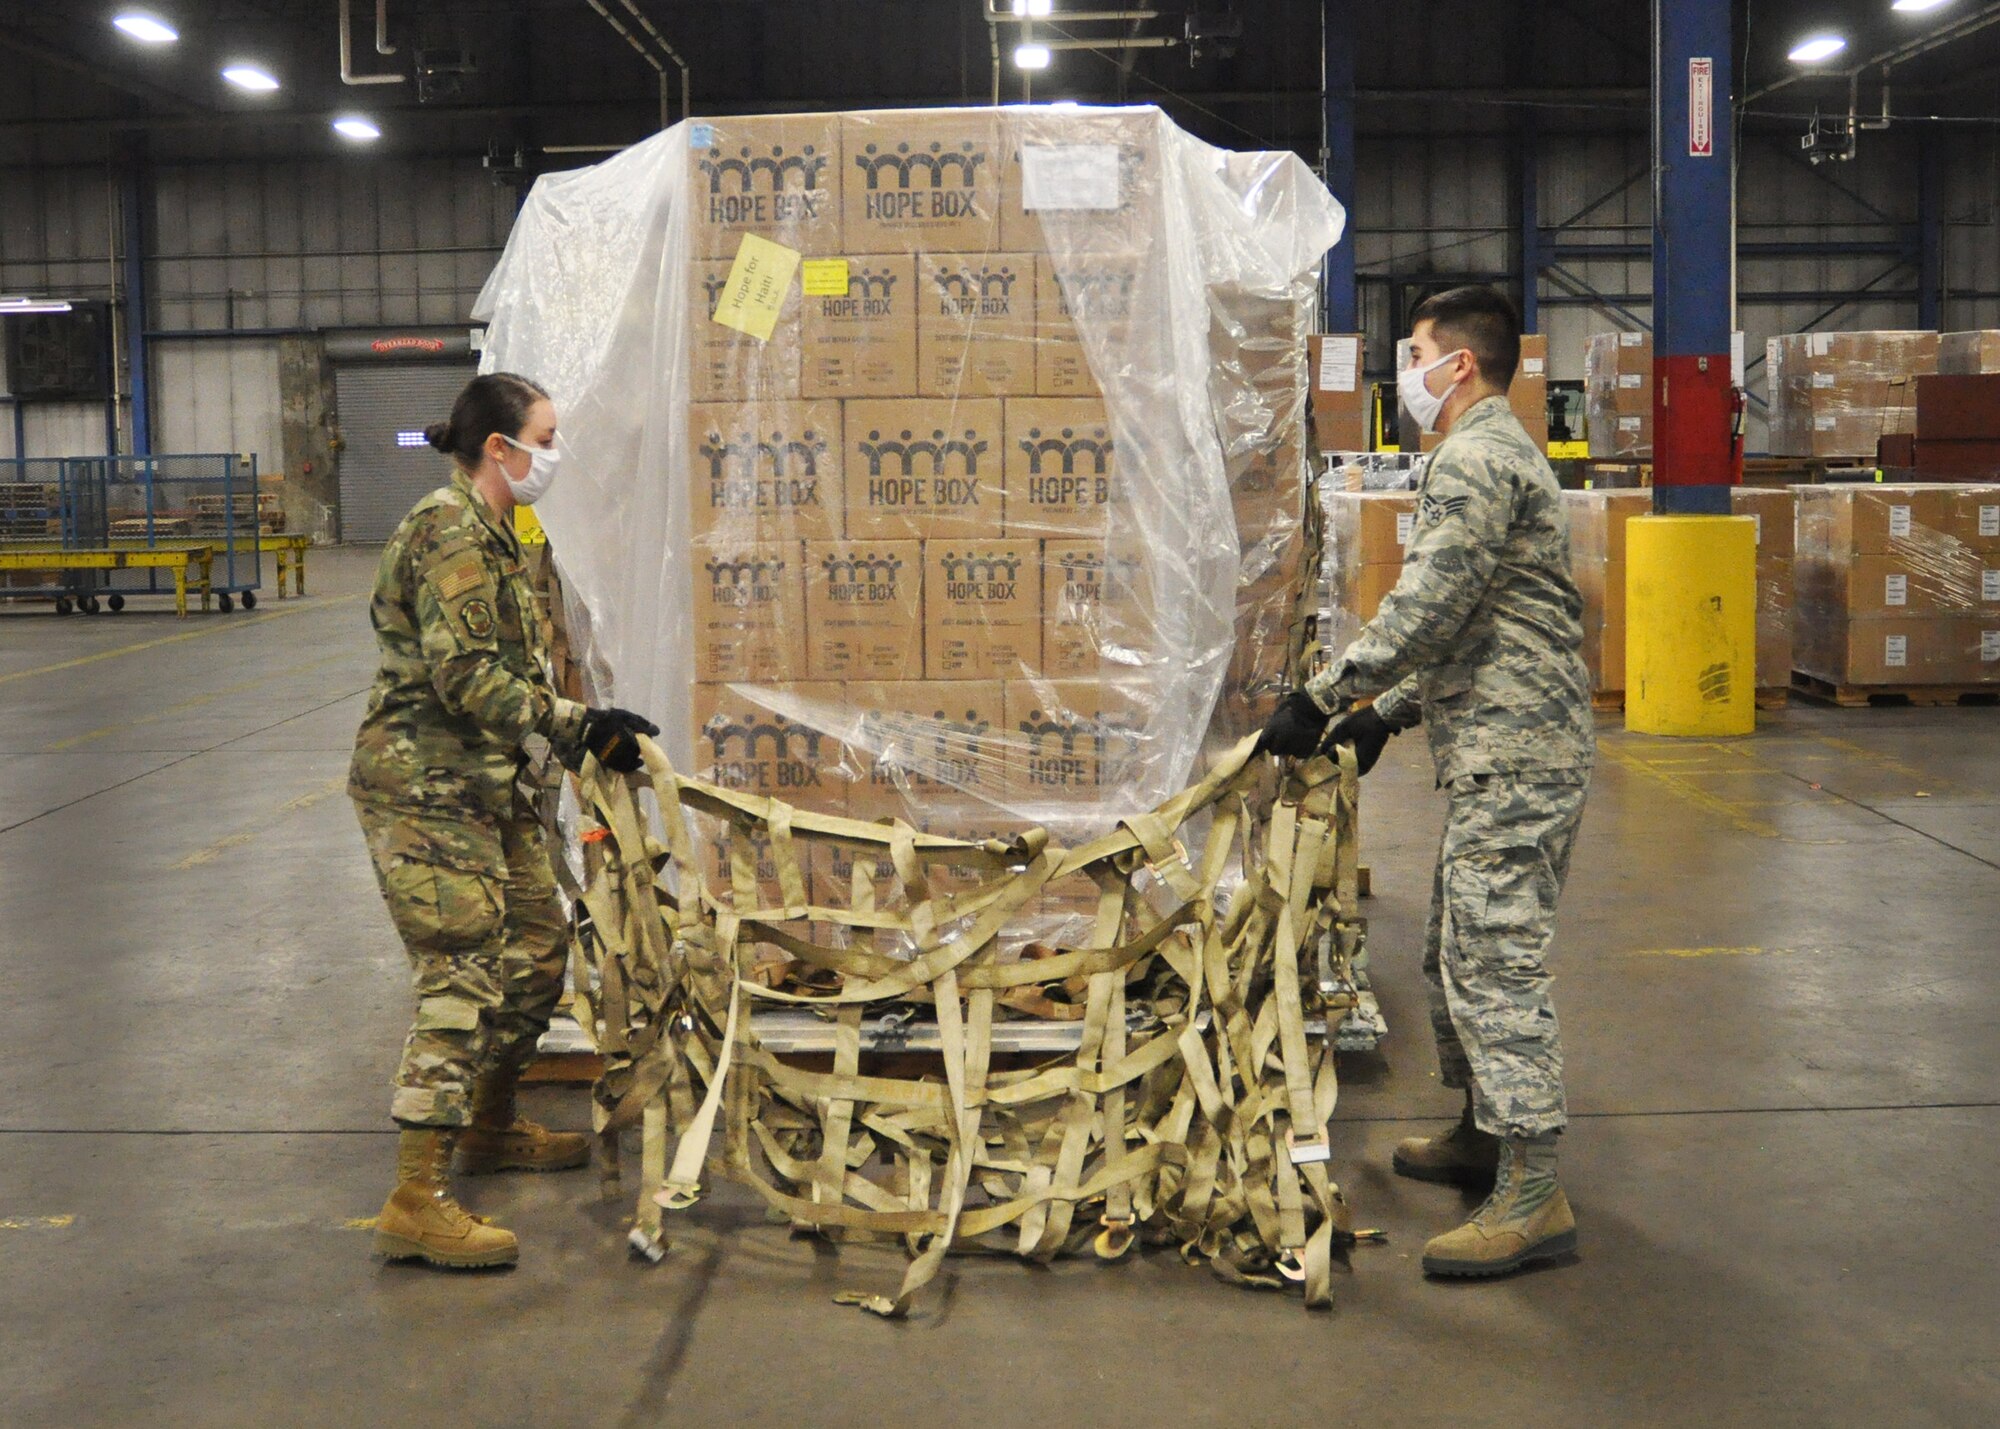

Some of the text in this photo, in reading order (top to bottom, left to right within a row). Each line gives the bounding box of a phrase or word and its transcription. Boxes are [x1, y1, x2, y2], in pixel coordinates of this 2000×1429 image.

[1692, 66, 1709, 76] FIRE
[710, 194, 818, 224] HOPE BOX
[866, 190, 977, 220] HOPE BOX
[732, 256, 760, 310] Hope for
[754, 274, 774, 305] Haiti
[822, 298, 891, 317] HOPE BOX
[981, 298, 1009, 315] BOX
[711, 480, 819, 507] HOPE BOX
[869, 478, 980, 506] HOPE BOX
[1029, 477, 1088, 504] HOPE
[712, 586, 750, 603] HO
[828, 583, 896, 601] HOPE BOX
[947, 582, 1017, 600] HOPE BOX
[713, 760, 822, 788] HOPE BOX
[1029, 759, 1087, 785] HOPE
[756, 861, 777, 879] BO
[832, 861, 853, 879] HO
